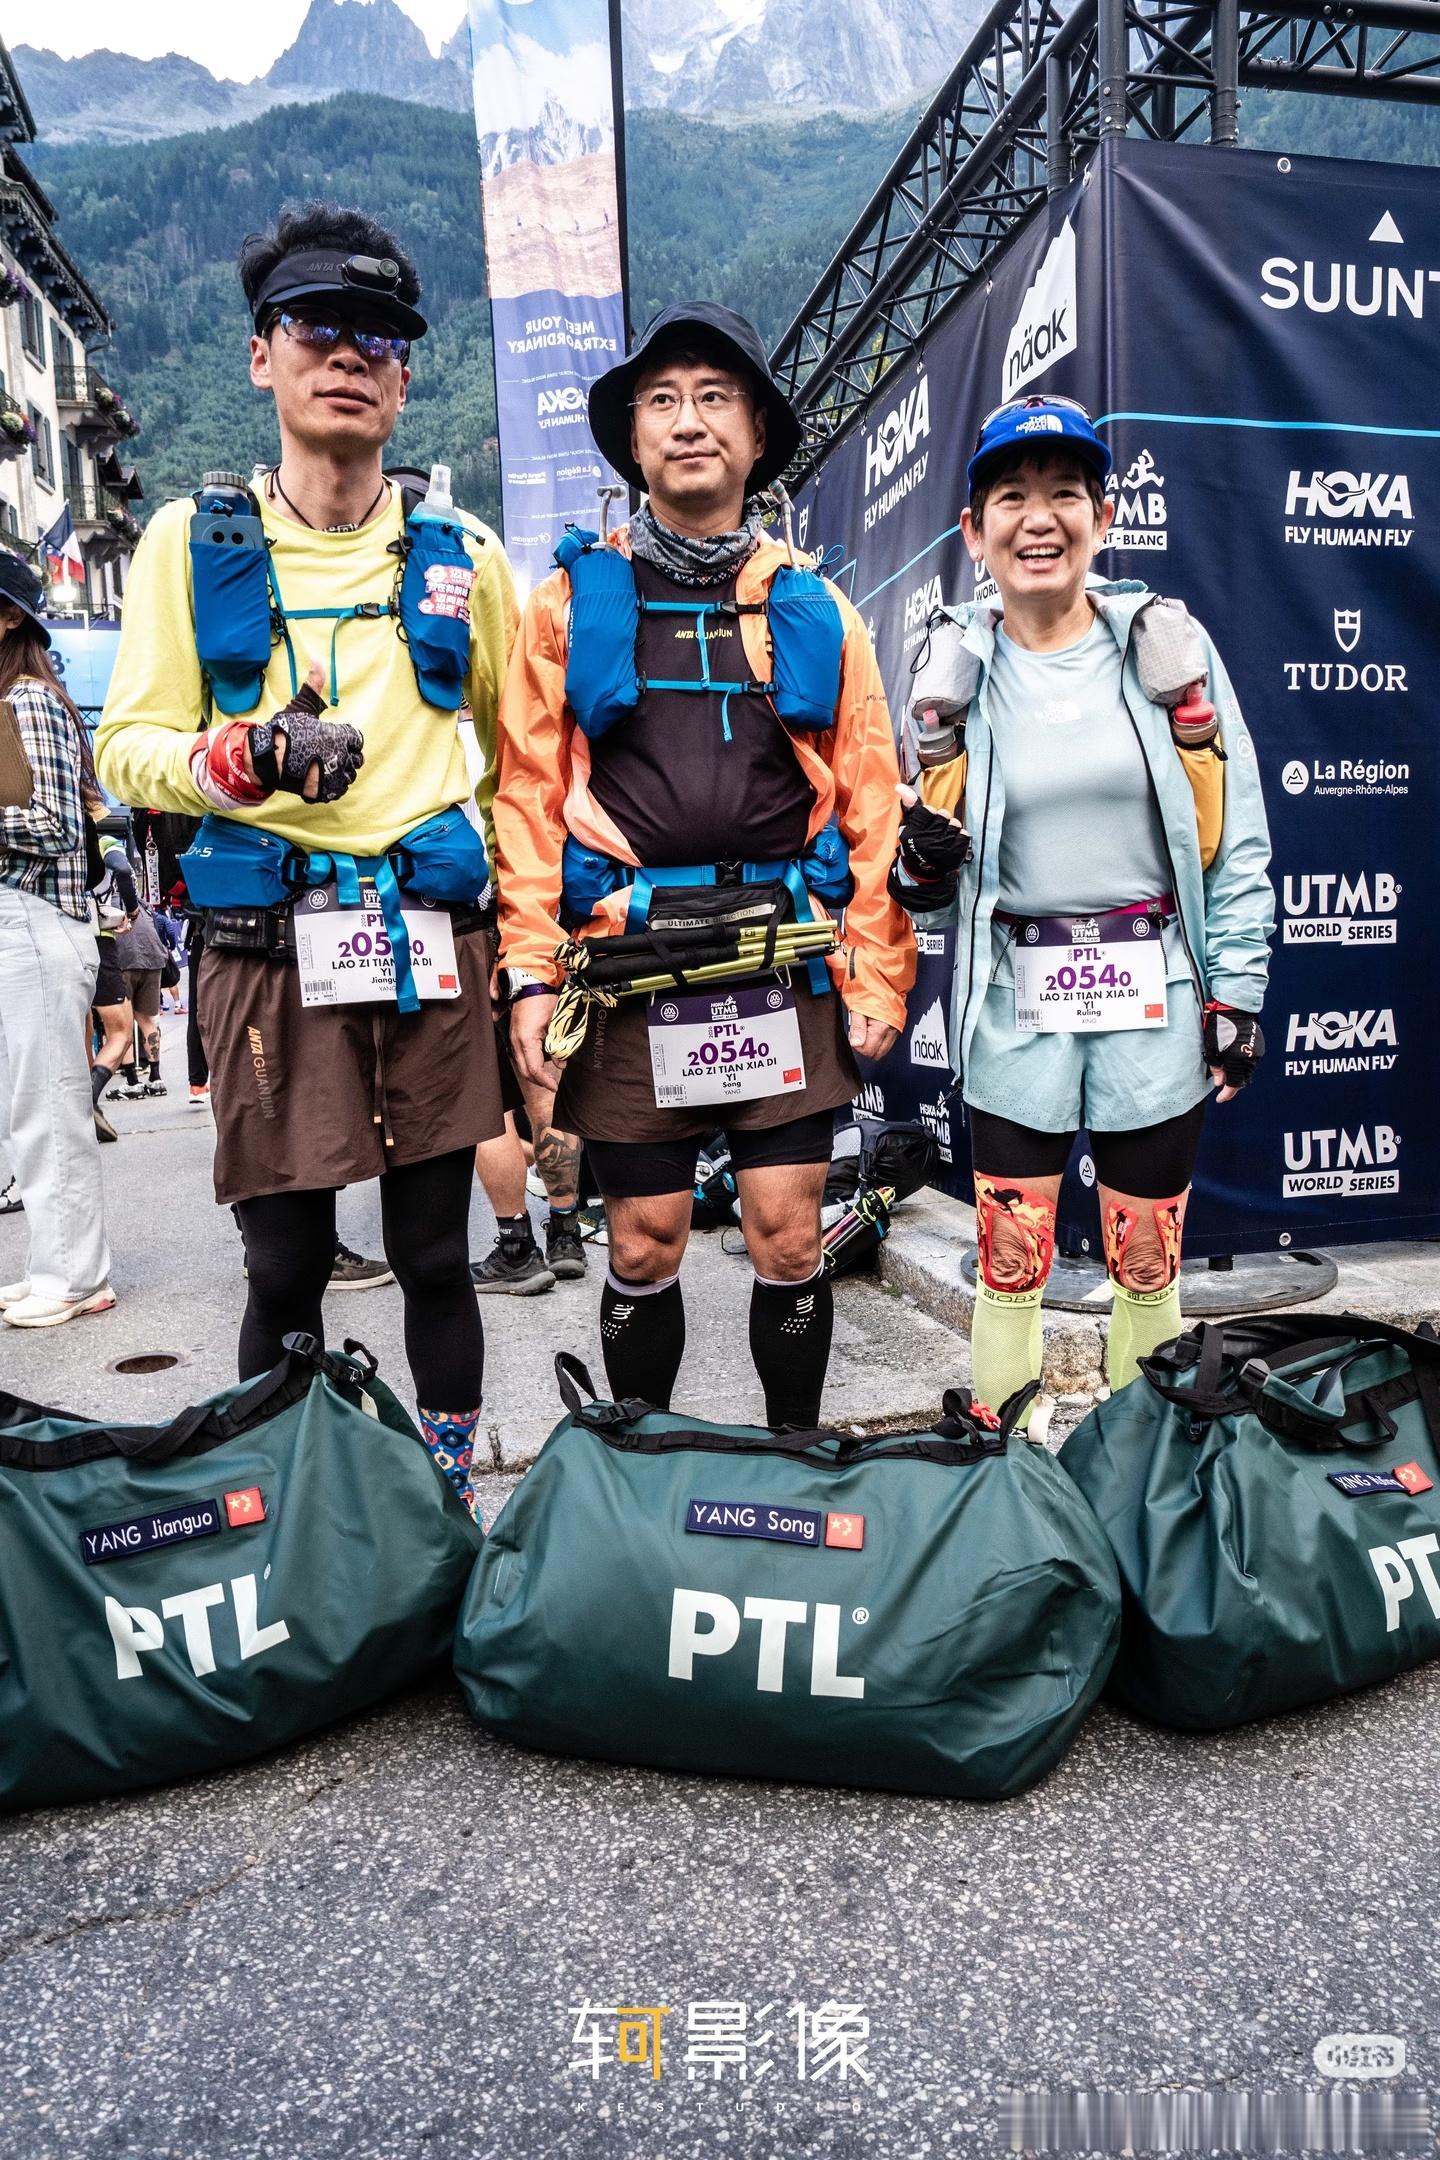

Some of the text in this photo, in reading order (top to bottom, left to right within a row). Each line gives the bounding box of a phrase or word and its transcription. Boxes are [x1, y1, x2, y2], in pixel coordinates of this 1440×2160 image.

[1009, 308, 1067, 387] näak
[865, 374, 931, 497] HOKA
[864, 451, 929, 533] FLY HUMAN FLY
[1284, 470, 1414, 519] HOKA
[1123, 535, 1164, 546] BLANC
[1285, 526, 1414, 546] FLY HUMAN FLY
[976, 582, 998, 601] WORL
[904, 575, 944, 632] HOKA
[675, 630, 694, 639] ANTA
[1284, 663, 1408, 692] TUDOR
[1314, 759, 1409, 783] La Région
[1314, 784, 1408, 797] Auvergne-Rhône-Alpes
[366, 914, 384, 927] PT
[668, 909, 755, 927] ULTIMATE DIRECTION
[1072, 927, 1100, 937] UTMB
[1289, 923, 1393, 939] WORLD SERIES
[338, 931, 425, 957] 2050
[926, 939, 944, 950] SERIES
[332, 961, 356, 970] LAO
[372, 958, 396, 967] TIAN
[423, 958, 432, 966] DI
[381, 967, 392, 976] YI
[371, 977, 397, 985] Jiangu
[1045, 964, 1131, 990] 20540
[1040, 989, 1138, 1001] LAO ZI TIAN XIA DI
[711, 1005, 738, 1015] UTMB
[1077, 1009, 1101, 1017] Ruling
[1083, 1001, 1094, 1009] YI
[593, 1009, 607, 1069] GUANJUN
[1285, 1009, 1399, 1052] HOKA
[688, 1037, 769, 1066] 20540
[914, 1034, 944, 1062] näak
[247, 1025, 276, 1119] ANTA GUANJUN
[682, 1057, 777, 1077] LAO ZI TIAN XIA DI
[1285, 1055, 1398, 1076] FLY HUMAN FLY
[726, 1073, 737, 1081] YI
[919, 1103, 937, 1117] HOKA
[1289, 1176, 1395, 1192] WORLD SERIES
[1336, 1475, 1371, 1488] XING
[694, 1504, 815, 1539] YANG Song
[86, 1512, 213, 1554] YANG Jianguo
[1368, 1533, 1440, 1632] PT
